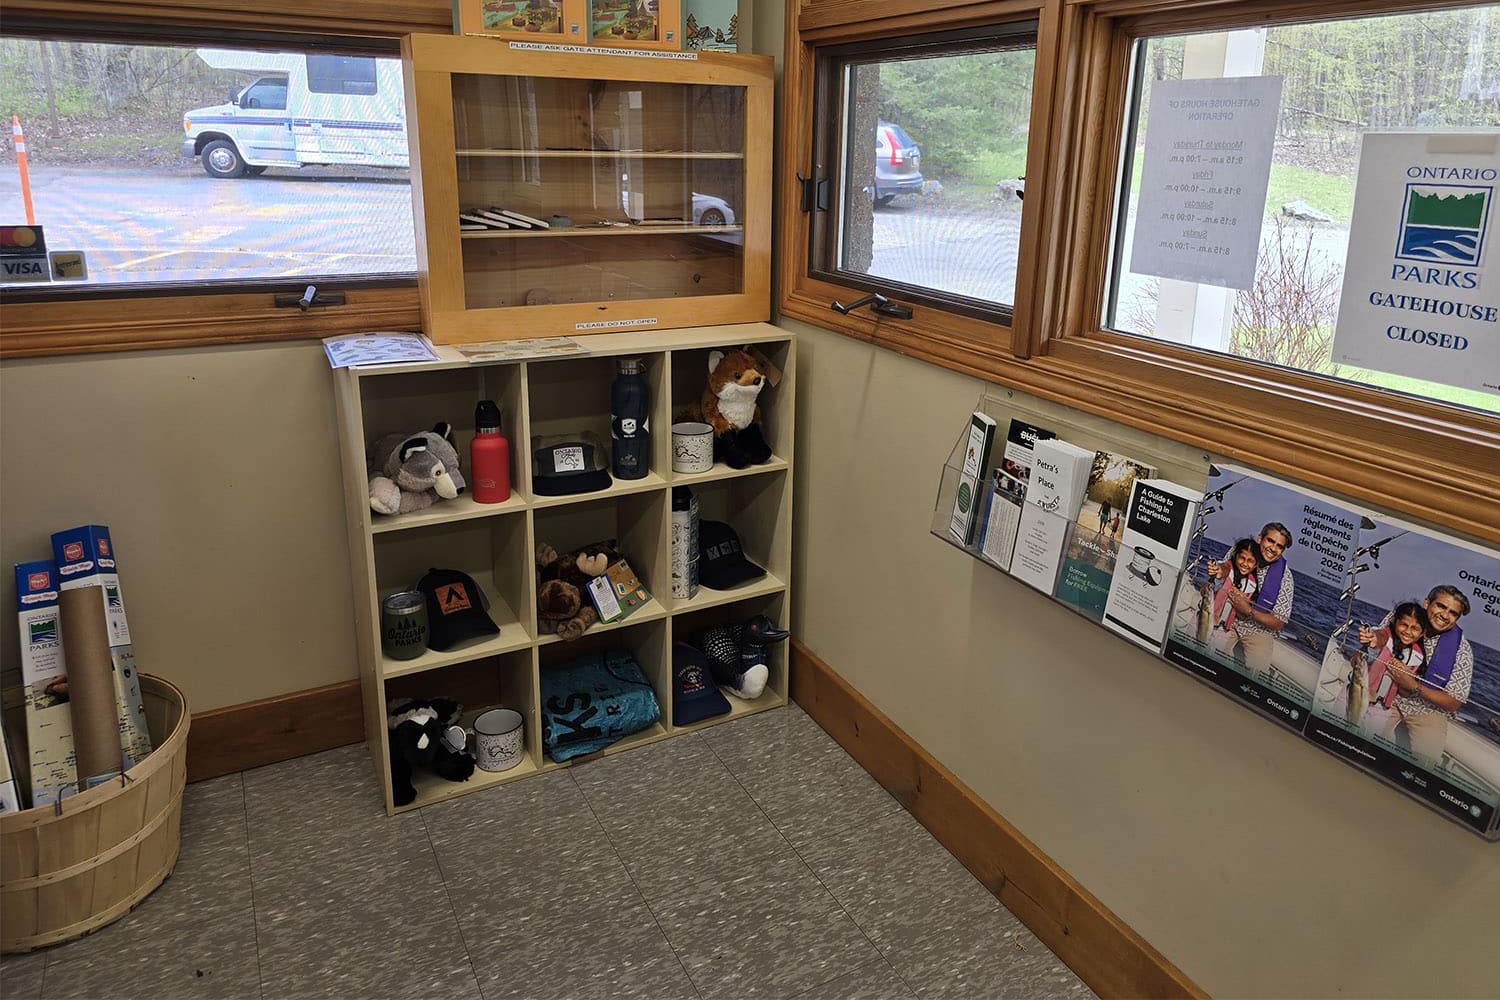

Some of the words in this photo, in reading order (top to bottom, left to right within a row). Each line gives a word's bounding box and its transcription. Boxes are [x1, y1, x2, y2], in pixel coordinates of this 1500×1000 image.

[510, 42, 543, 50] PLEASE
[586, 47, 632, 56] ATTENDANT
[651, 52, 697, 60] ASSISTANCE
[1406, 166, 1498, 181] ONTARIO
[4, 263, 42, 275] VISA
[1391, 264, 1479, 289] PARKS
[1369, 291, 1498, 323] GATEHOUSE
[1386, 325, 1469, 351] CLOSED
[1036, 458, 1059, 474] Petra's
[1038, 476, 1055, 490] Place
[1140, 496, 1162, 513] Fishing
[1141, 488, 1147, 496] A
[1147, 490, 1166, 504] Guide
[1166, 498, 1174, 506] to
[1136, 512, 1151, 524] Lake
[1138, 504, 1171, 524] Charleston
[1303, 504, 1338, 524] Résumé
[1338, 518, 1355, 531] des
[1303, 517, 1352, 541] règlements
[1077, 537, 1100, 552] Tackle
[1300, 527, 1312, 537] de
[1313, 530, 1321, 541] la
[1321, 536, 1349, 552] pêche
[1298, 537, 1310, 547] de
[1310, 541, 1346, 562] l'Ontario
[1320, 557, 1344, 573] 2026
[388, 625, 426, 640] Ontario
[29, 641, 60, 652] PARKS
[394, 638, 422, 647] PARKS
[1266, 697, 1290, 715] Ontario
[1439, 789, 1469, 811] Ontario
